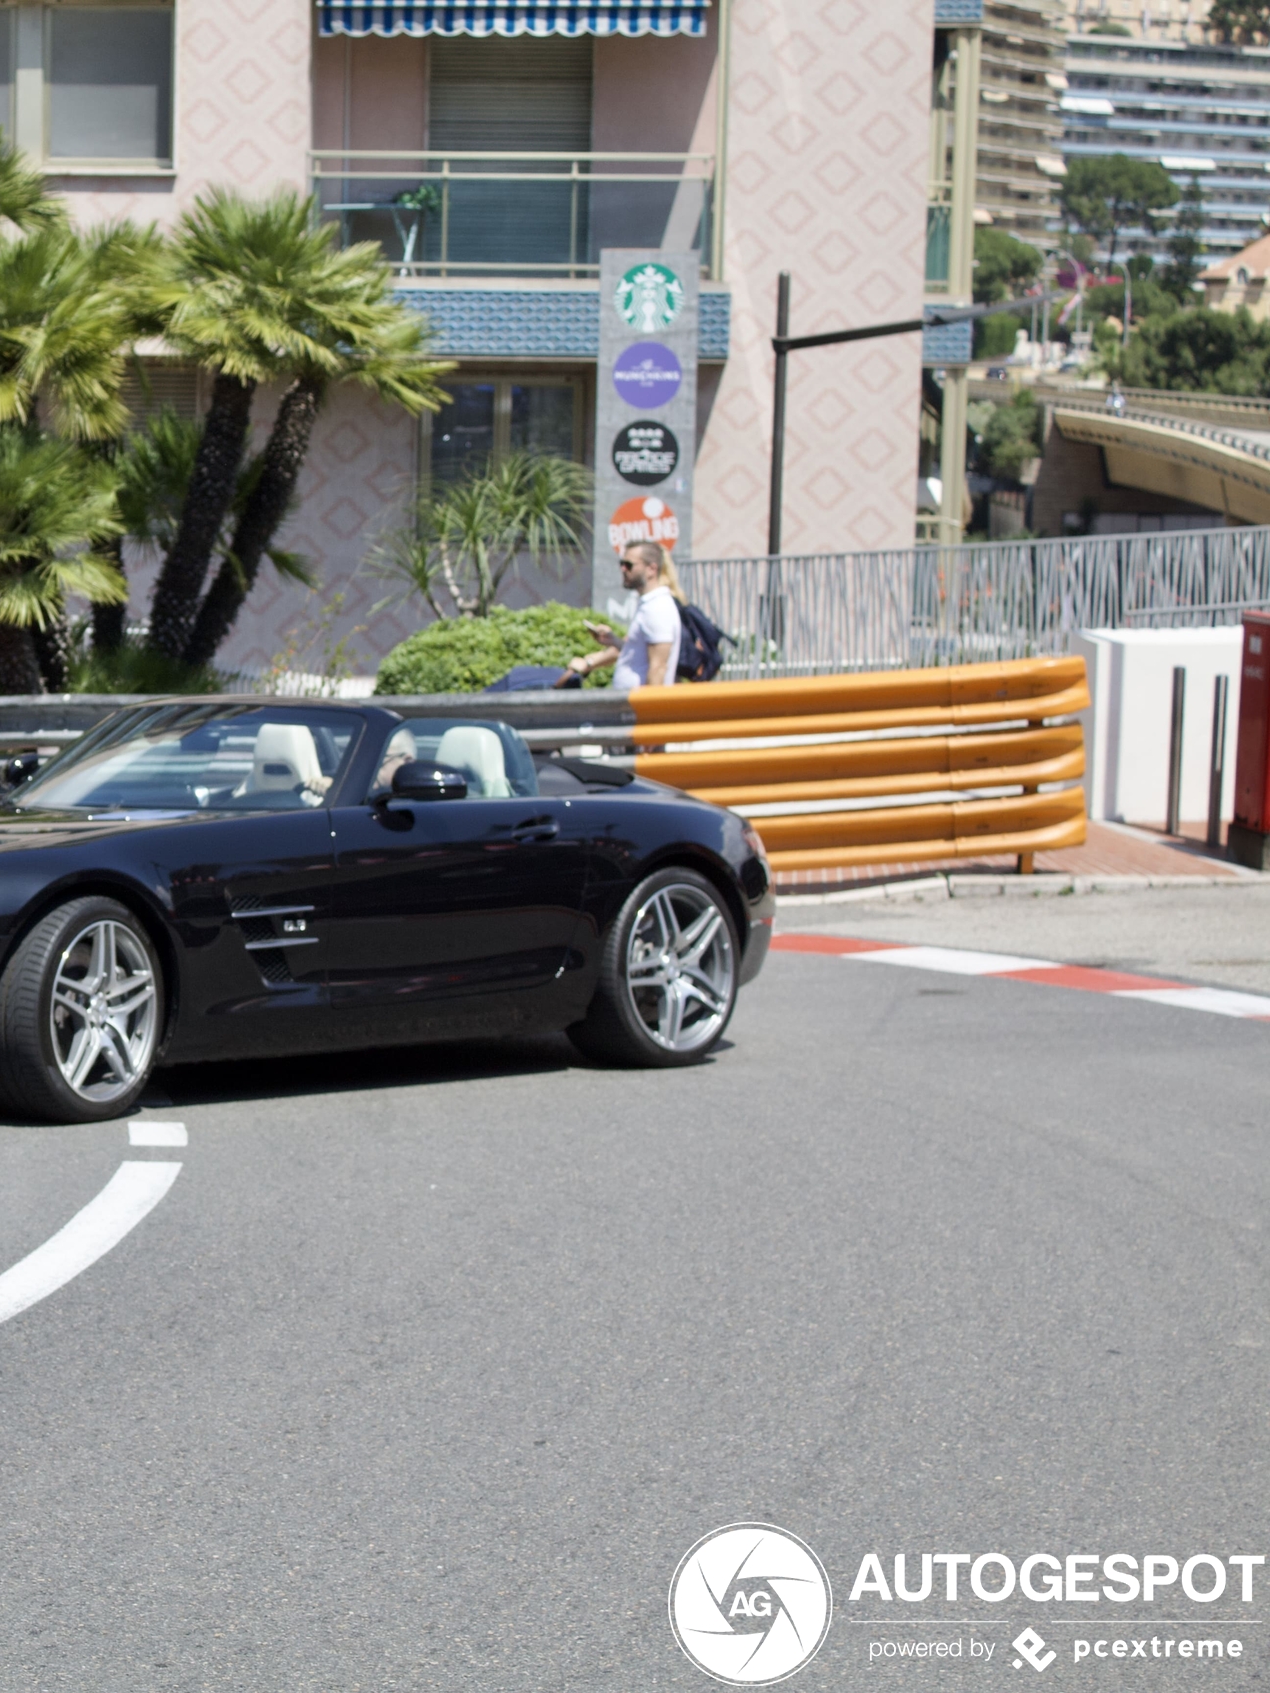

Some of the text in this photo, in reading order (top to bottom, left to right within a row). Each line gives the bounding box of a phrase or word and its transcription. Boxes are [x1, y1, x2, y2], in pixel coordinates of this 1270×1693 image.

[613, 370, 680, 381] MUNCHKINS
[614, 450, 675, 464] ARCADE
[619, 462, 671, 473] GAMES
[608, 516, 679, 547] BOWLING
